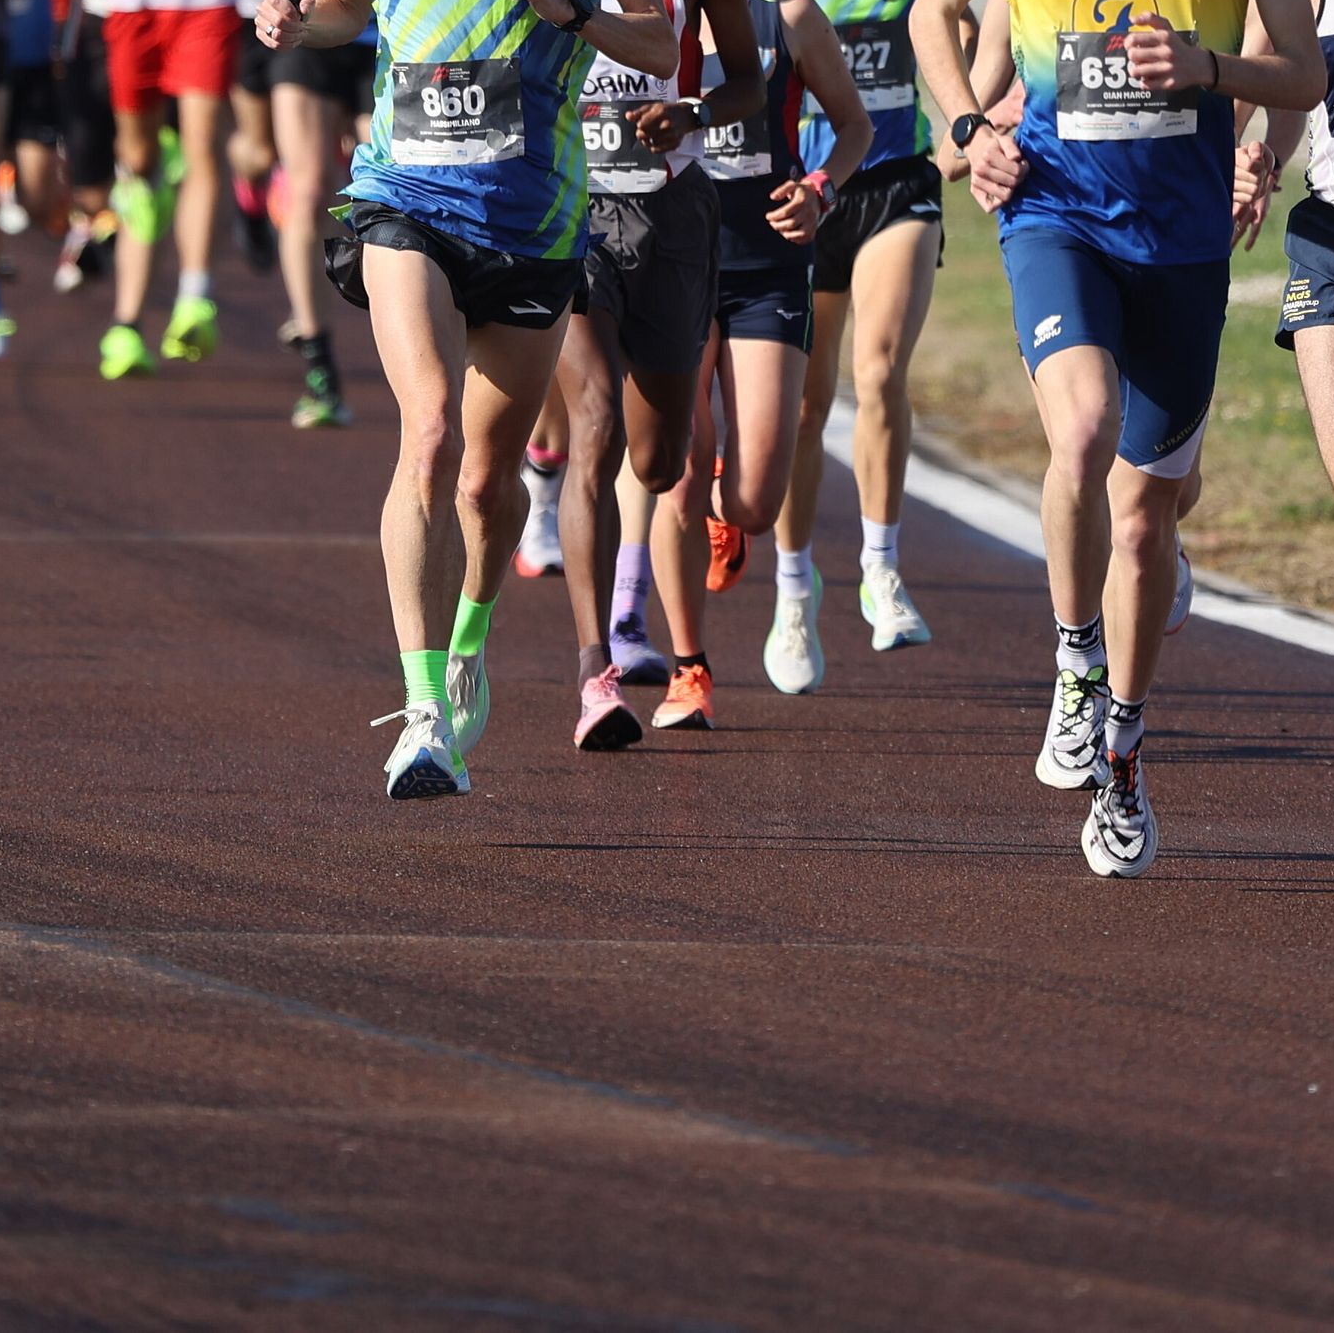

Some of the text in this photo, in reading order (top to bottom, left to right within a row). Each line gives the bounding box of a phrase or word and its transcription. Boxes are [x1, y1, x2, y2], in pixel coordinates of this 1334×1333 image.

[1061, 43, 1075, 61] A
[398, 71, 408, 85] A
[421, 84, 486, 118] 860
[1103, 91, 1152, 100] GIAN MARCO
